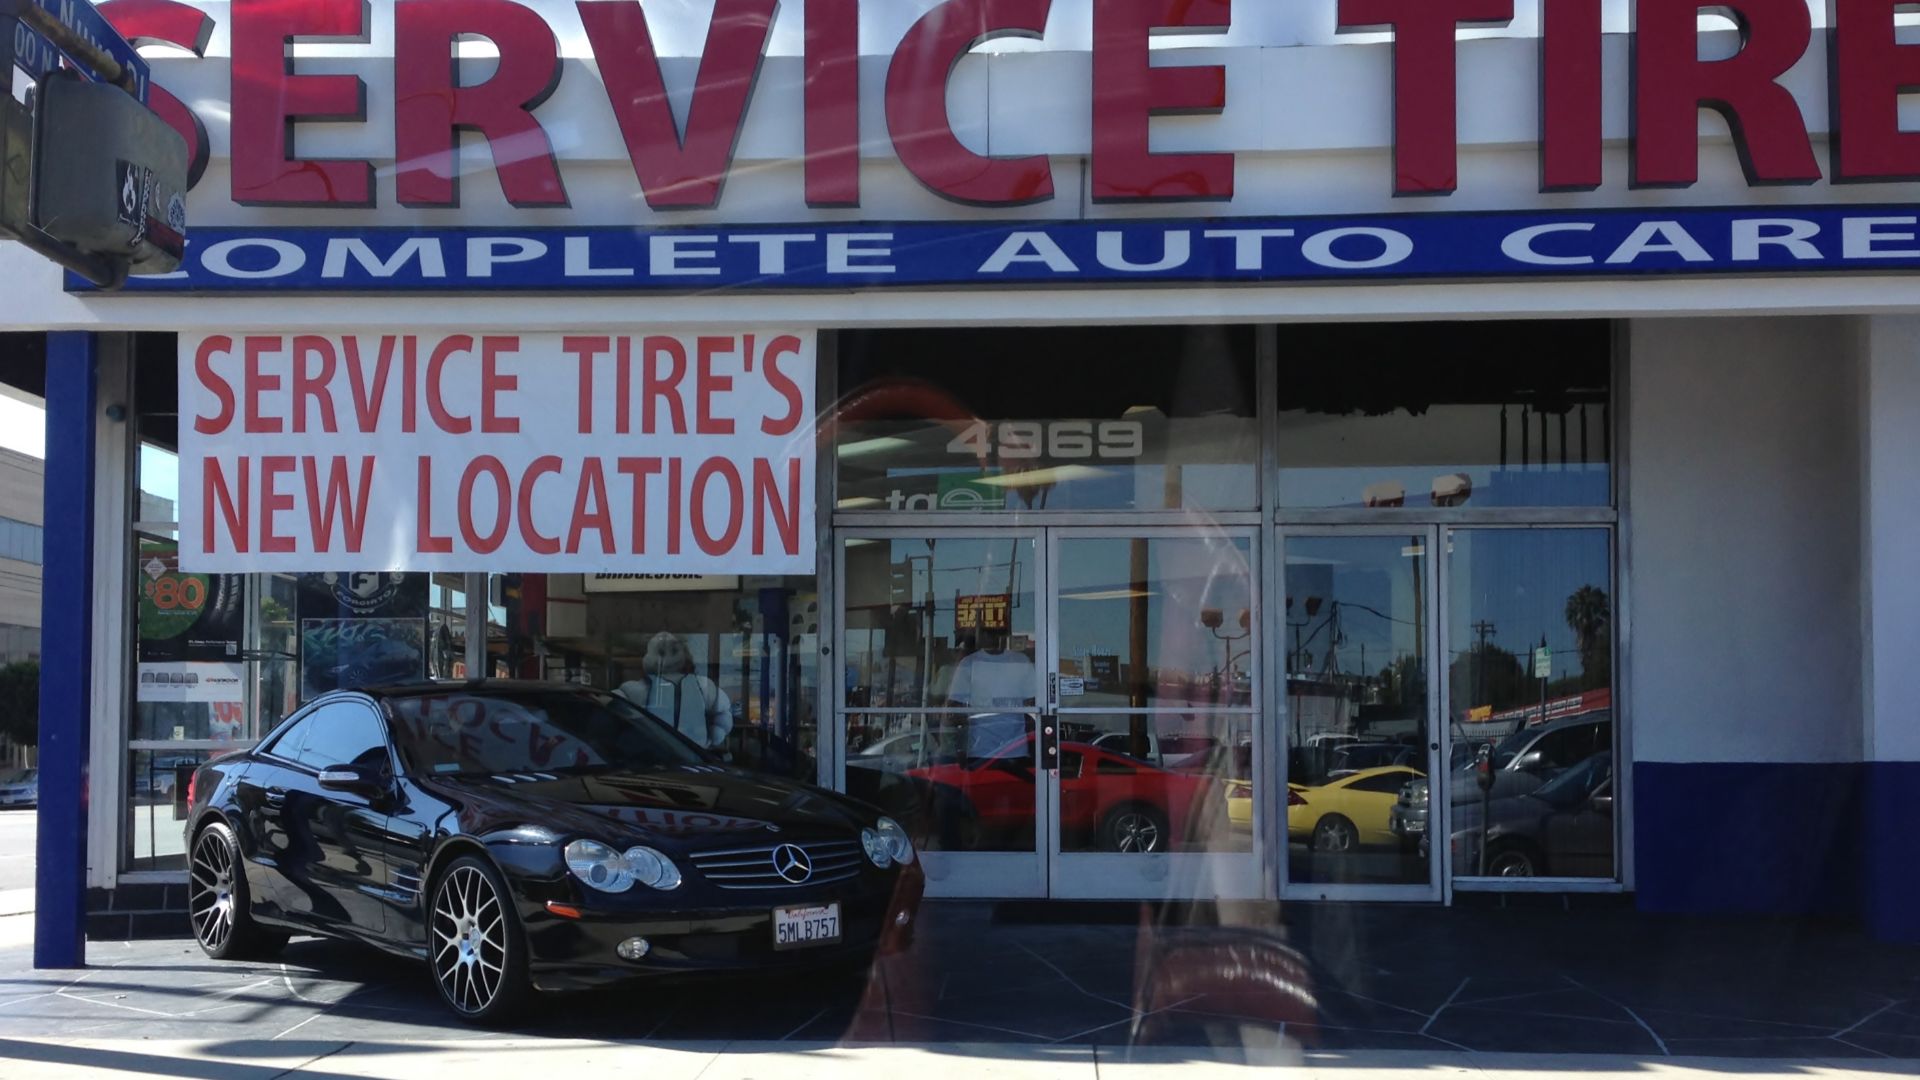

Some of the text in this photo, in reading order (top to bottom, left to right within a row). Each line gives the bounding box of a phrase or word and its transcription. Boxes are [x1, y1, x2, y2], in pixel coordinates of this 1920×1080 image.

[1335, 0, 1920, 199] TIRE
[127, 216, 1920, 279] OMPLETE AUTO CARE
[194, 334, 803, 436] SERVICE TIRE'S
[946, 421, 1143, 458] 4969
[203, 455, 801, 556] NEW LOCATION
[145, 576, 206, 610] $80
[778, 917, 837, 943] 5MLB757
